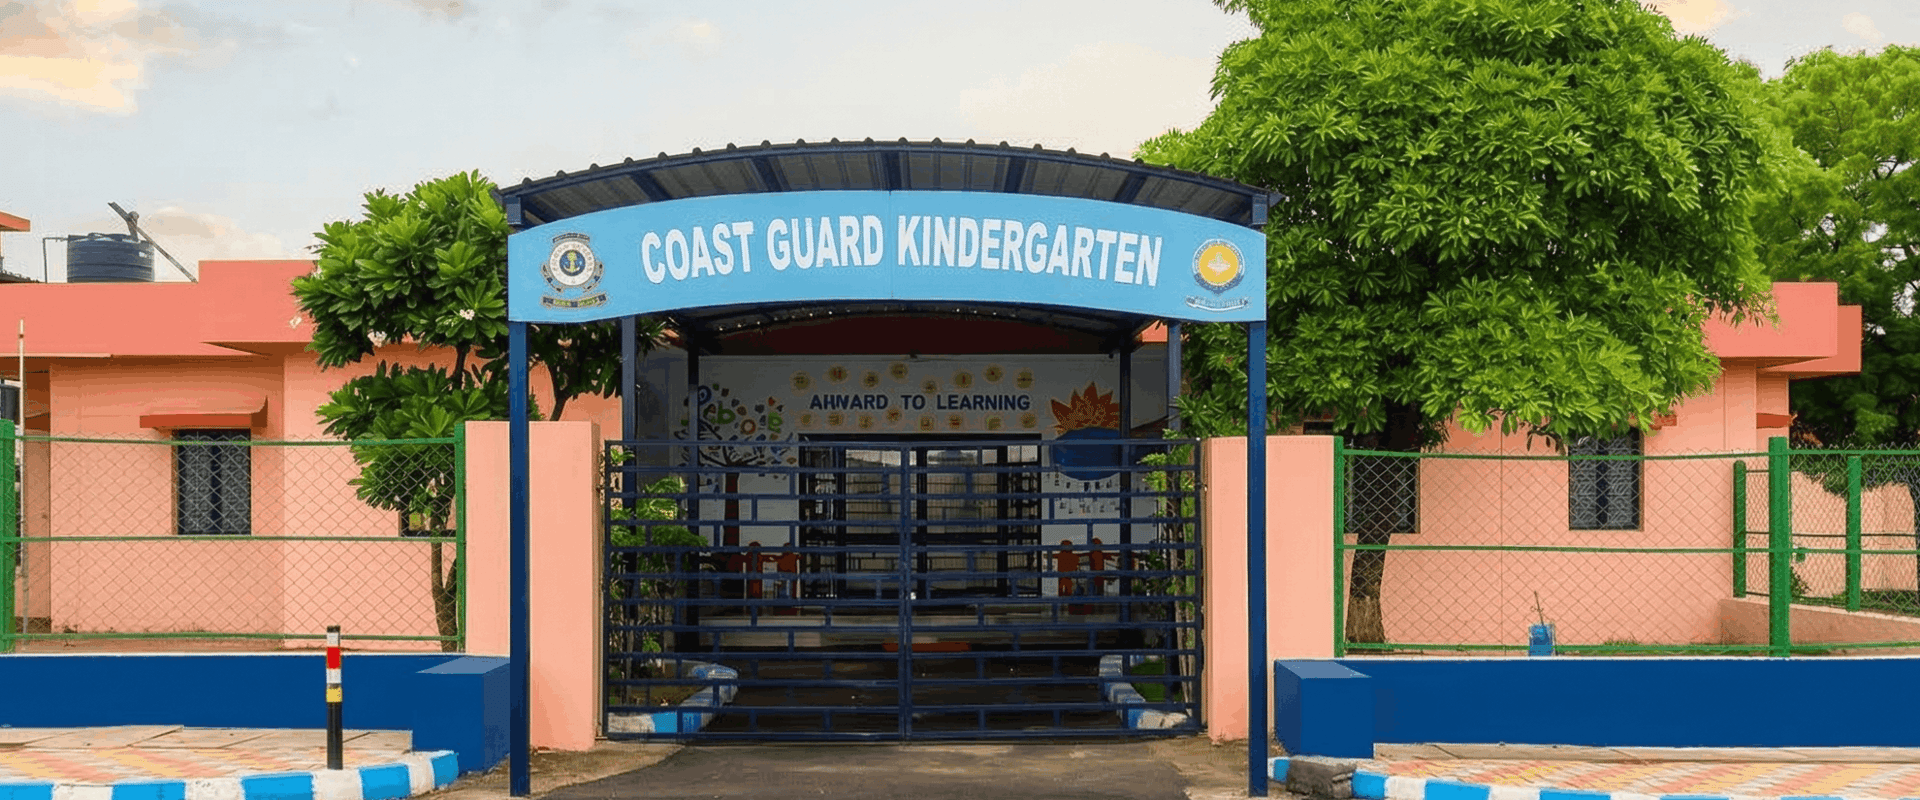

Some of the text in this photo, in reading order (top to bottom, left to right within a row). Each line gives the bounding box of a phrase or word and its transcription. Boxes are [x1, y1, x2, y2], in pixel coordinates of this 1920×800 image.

[642, 220, 755, 284] COAST
[767, 215, 884, 271] GUARD
[898, 215, 1163, 287] KINDERGARTEN
[900, 393, 926, 411] TO
[936, 393, 1031, 411] LEARNING
